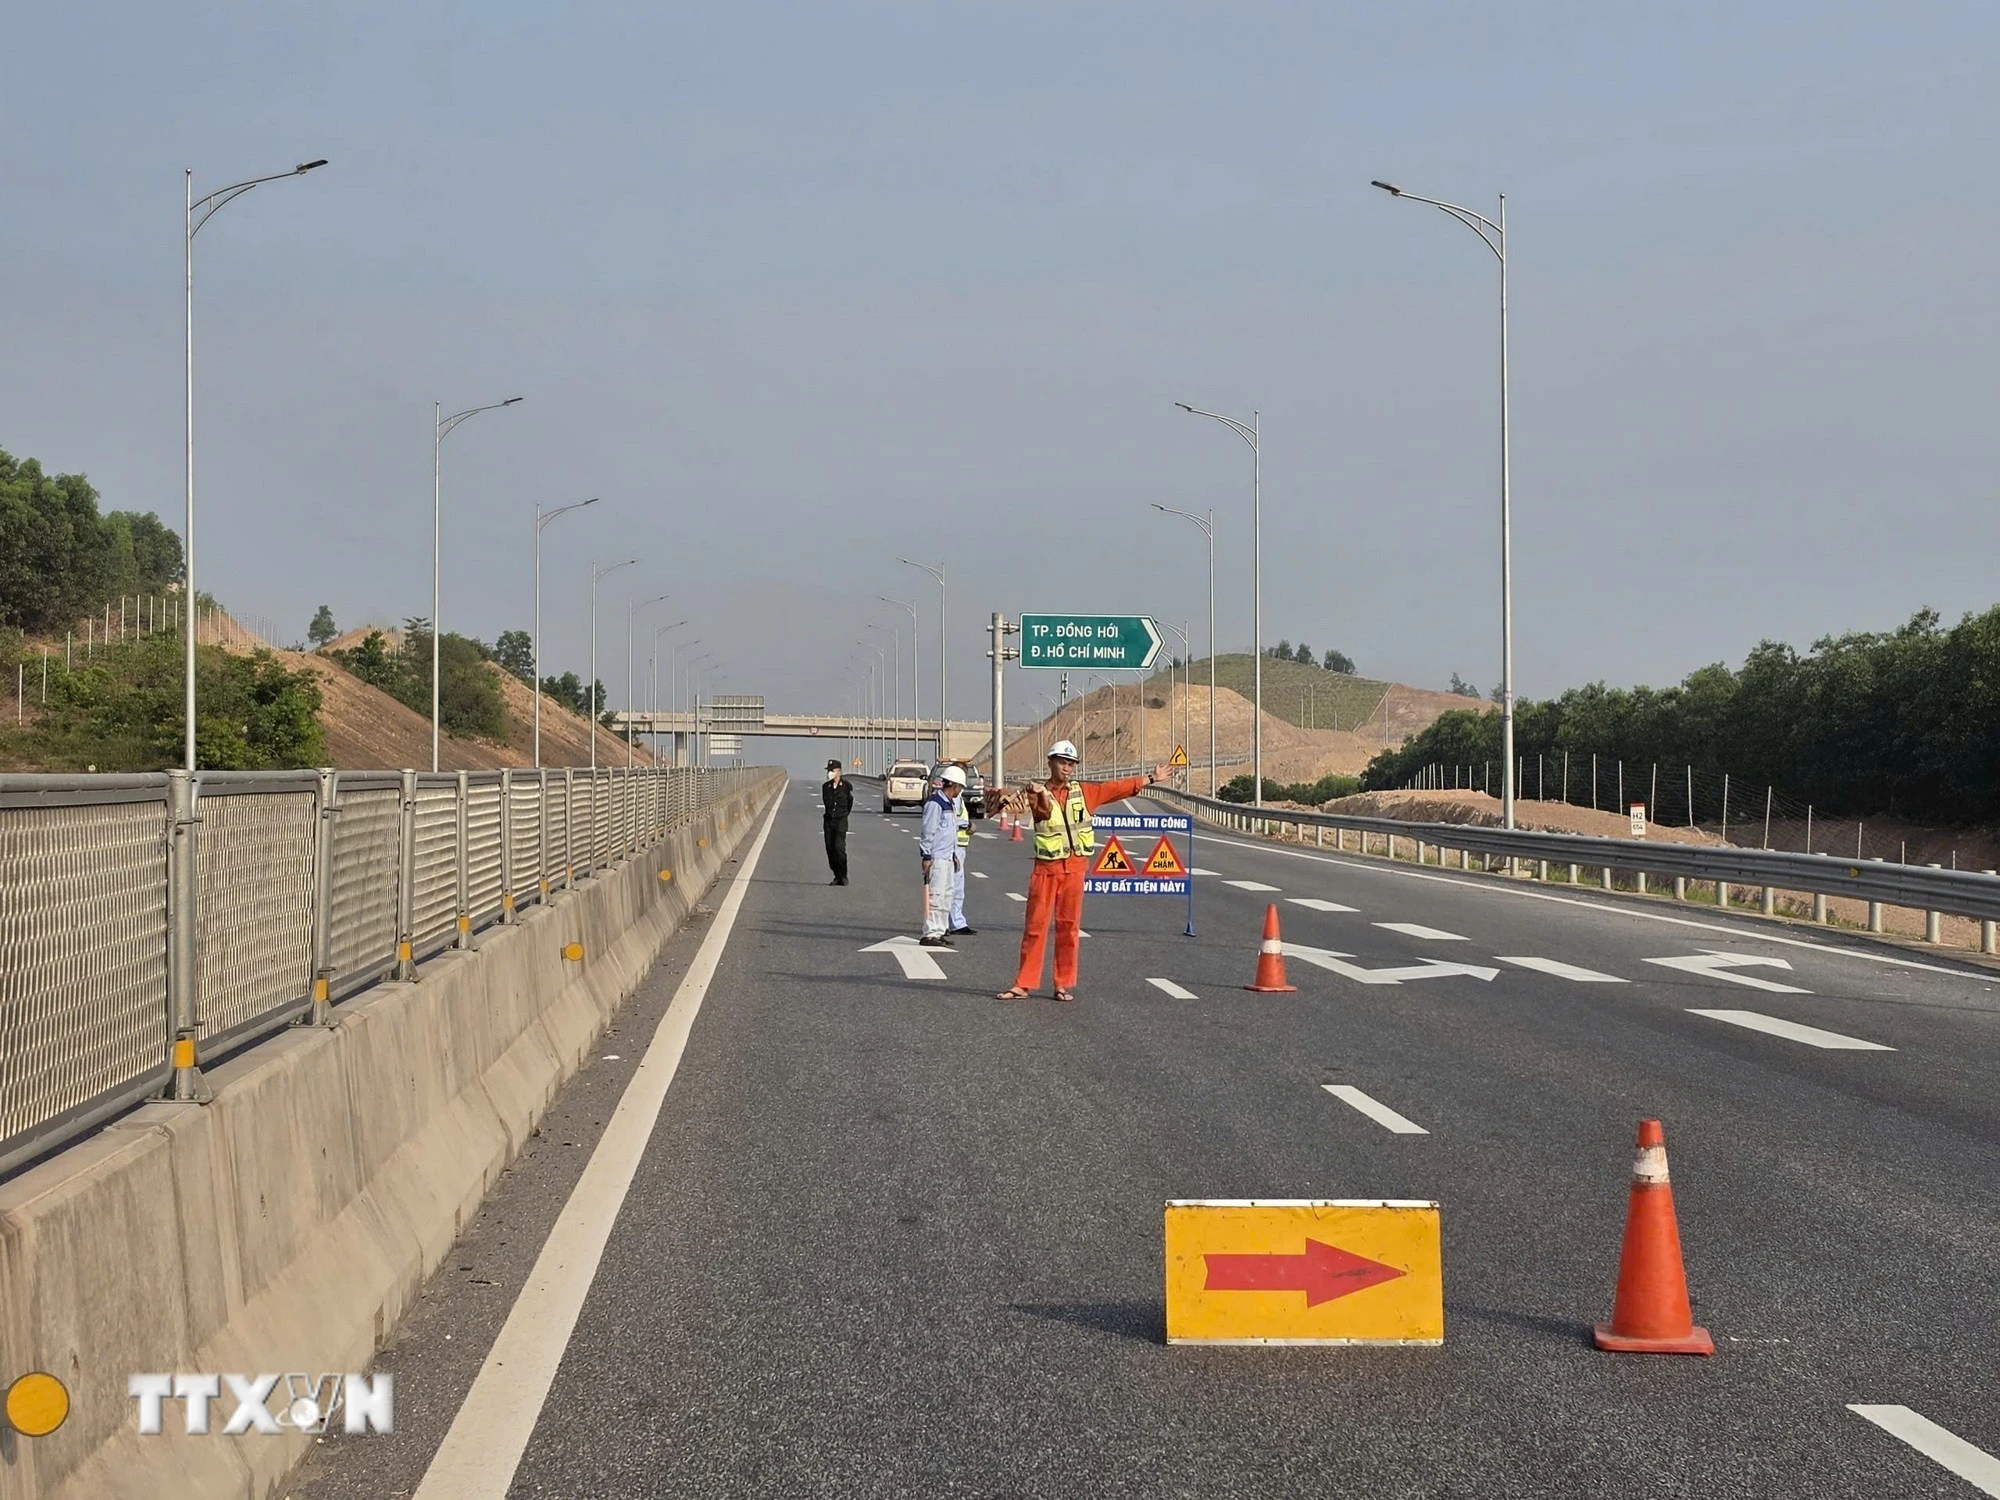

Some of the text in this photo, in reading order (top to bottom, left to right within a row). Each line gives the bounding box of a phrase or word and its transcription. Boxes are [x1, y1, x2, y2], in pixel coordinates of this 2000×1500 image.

[1056, 622, 1092, 637] ĐỒNG
[1097, 623, 1118, 638] HỚI
[1069, 643, 1090, 658] CHÍ
[1093, 647, 1125, 659] MINH
[1092, 814, 1187, 828] ỜNG ĐANG THI CÔNG
[1632, 812, 1643, 820] H2
[1095, 881, 1111, 893] SỰ
[1112, 879, 1132, 892] BẤT
[1134, 880, 1157, 894] TIỆN
[1160, 881, 1185, 892] NÀY!
